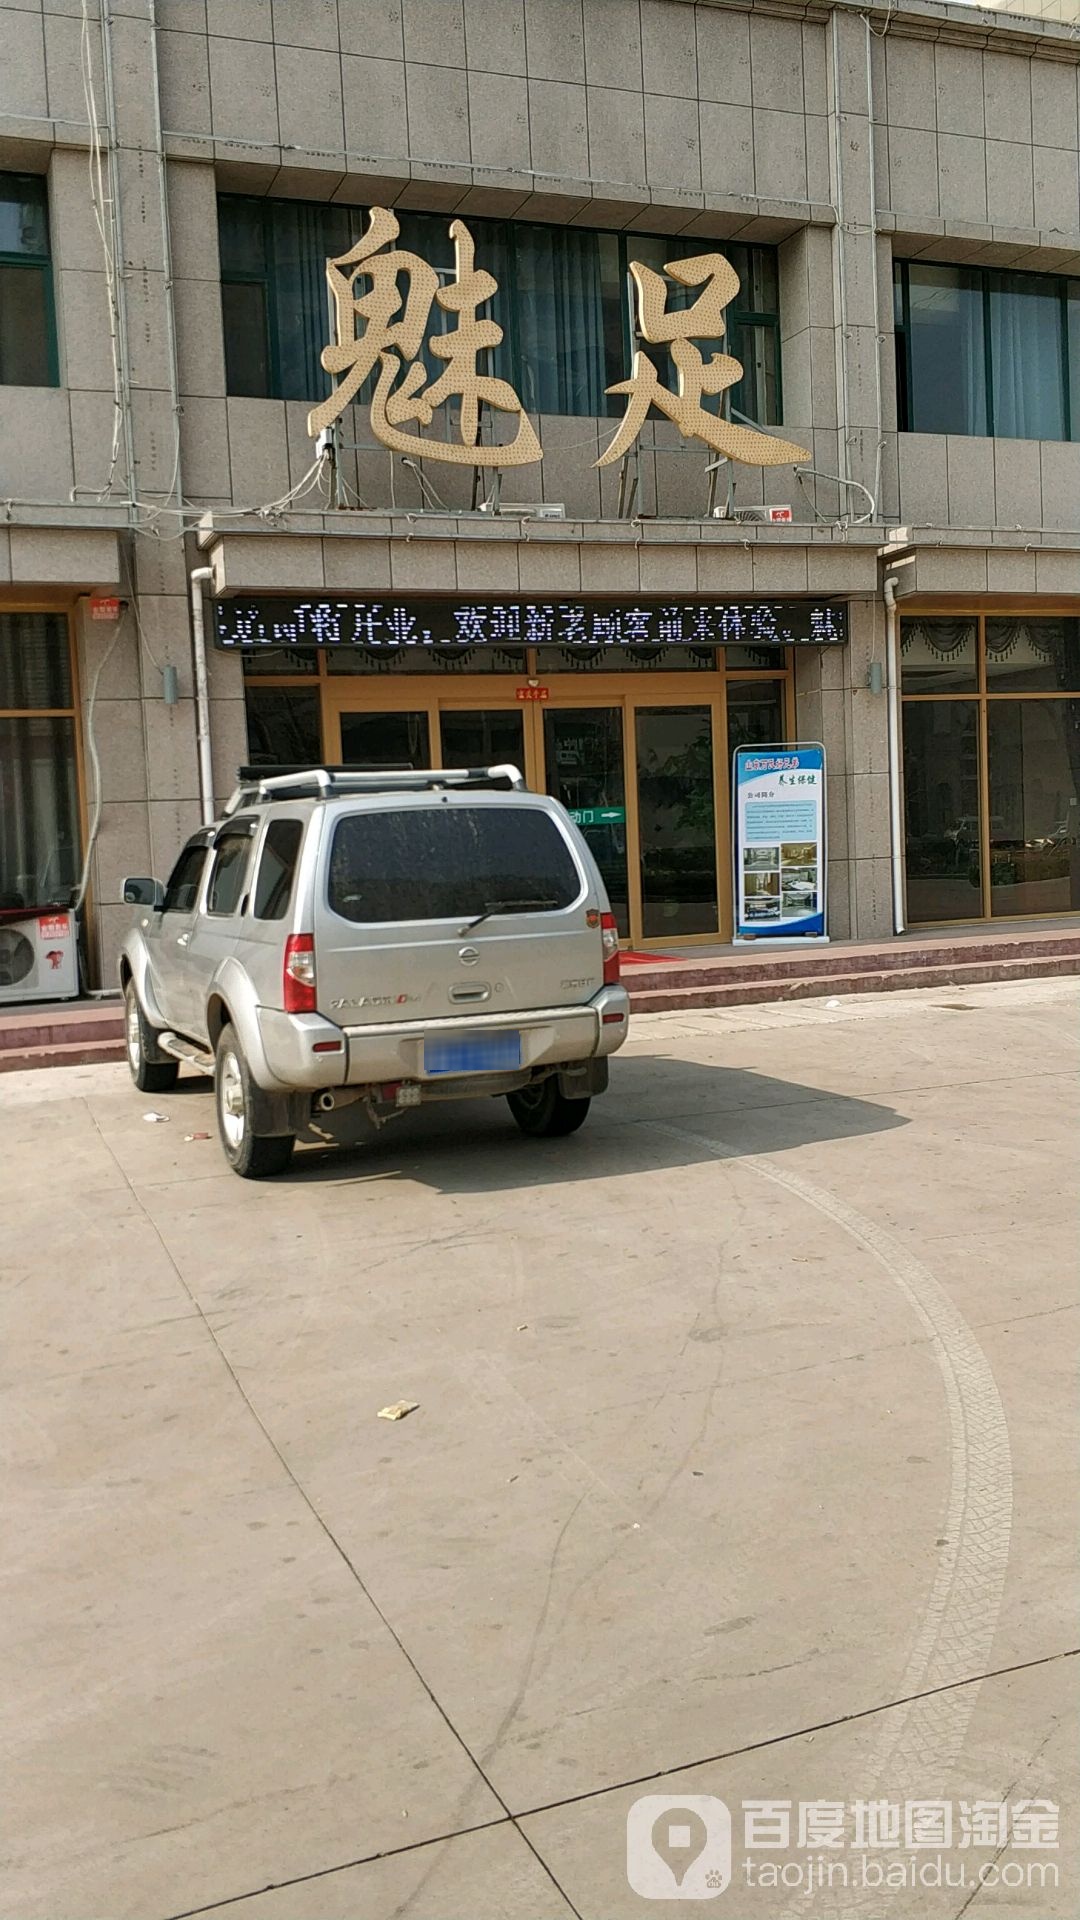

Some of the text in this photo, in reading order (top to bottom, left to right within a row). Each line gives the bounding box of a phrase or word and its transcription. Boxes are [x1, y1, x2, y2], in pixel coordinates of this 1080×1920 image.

[306, 206, 813, 468] 魅足
[778, 774, 818, 786] 养生保健
